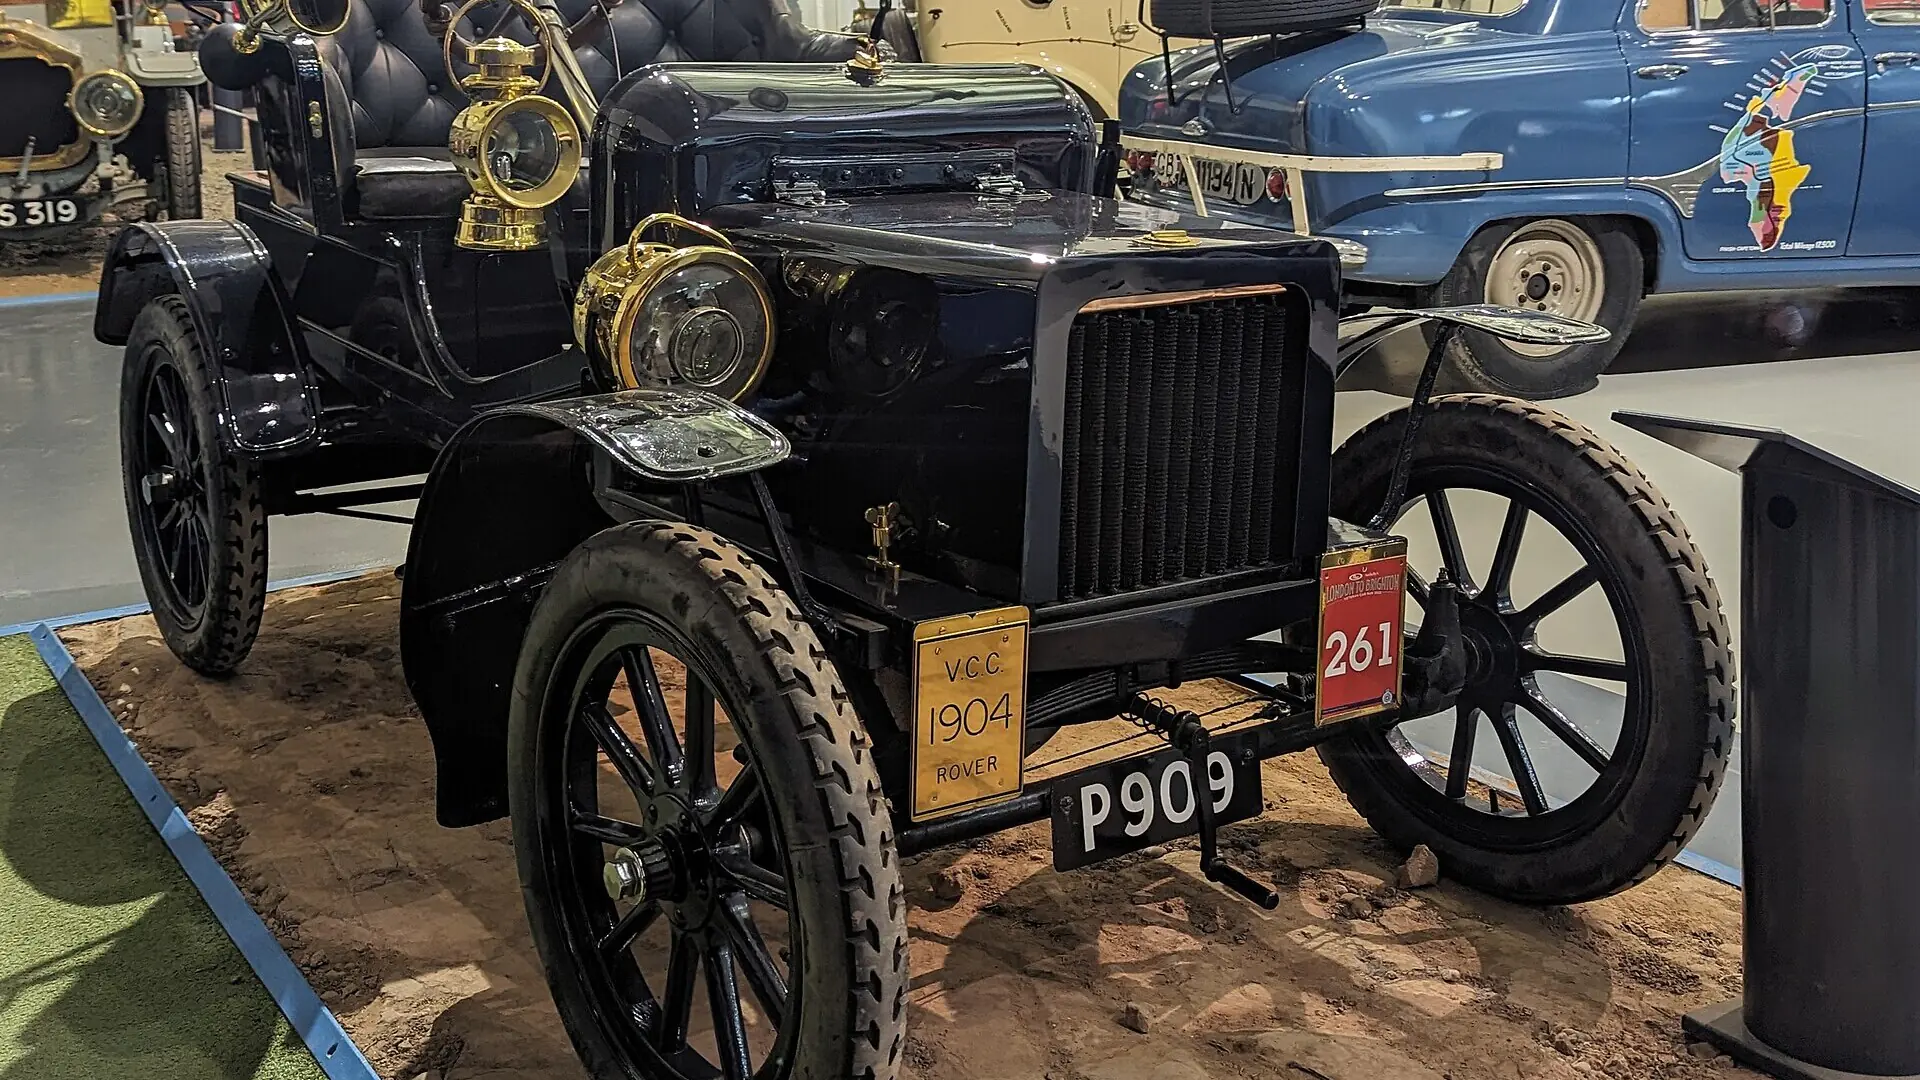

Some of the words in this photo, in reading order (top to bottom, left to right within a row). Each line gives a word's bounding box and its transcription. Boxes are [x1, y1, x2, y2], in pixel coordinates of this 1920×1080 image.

[24, 199, 78, 225] 319
[1326, 581, 1355, 603] LONDON
[1355, 580, 1364, 593] TO
[1365, 574, 1400, 592] BRIGHTON
[1325, 622, 1392, 678] 261
[929, 692, 1013, 746] 1904
[937, 756, 998, 784] ROVER
